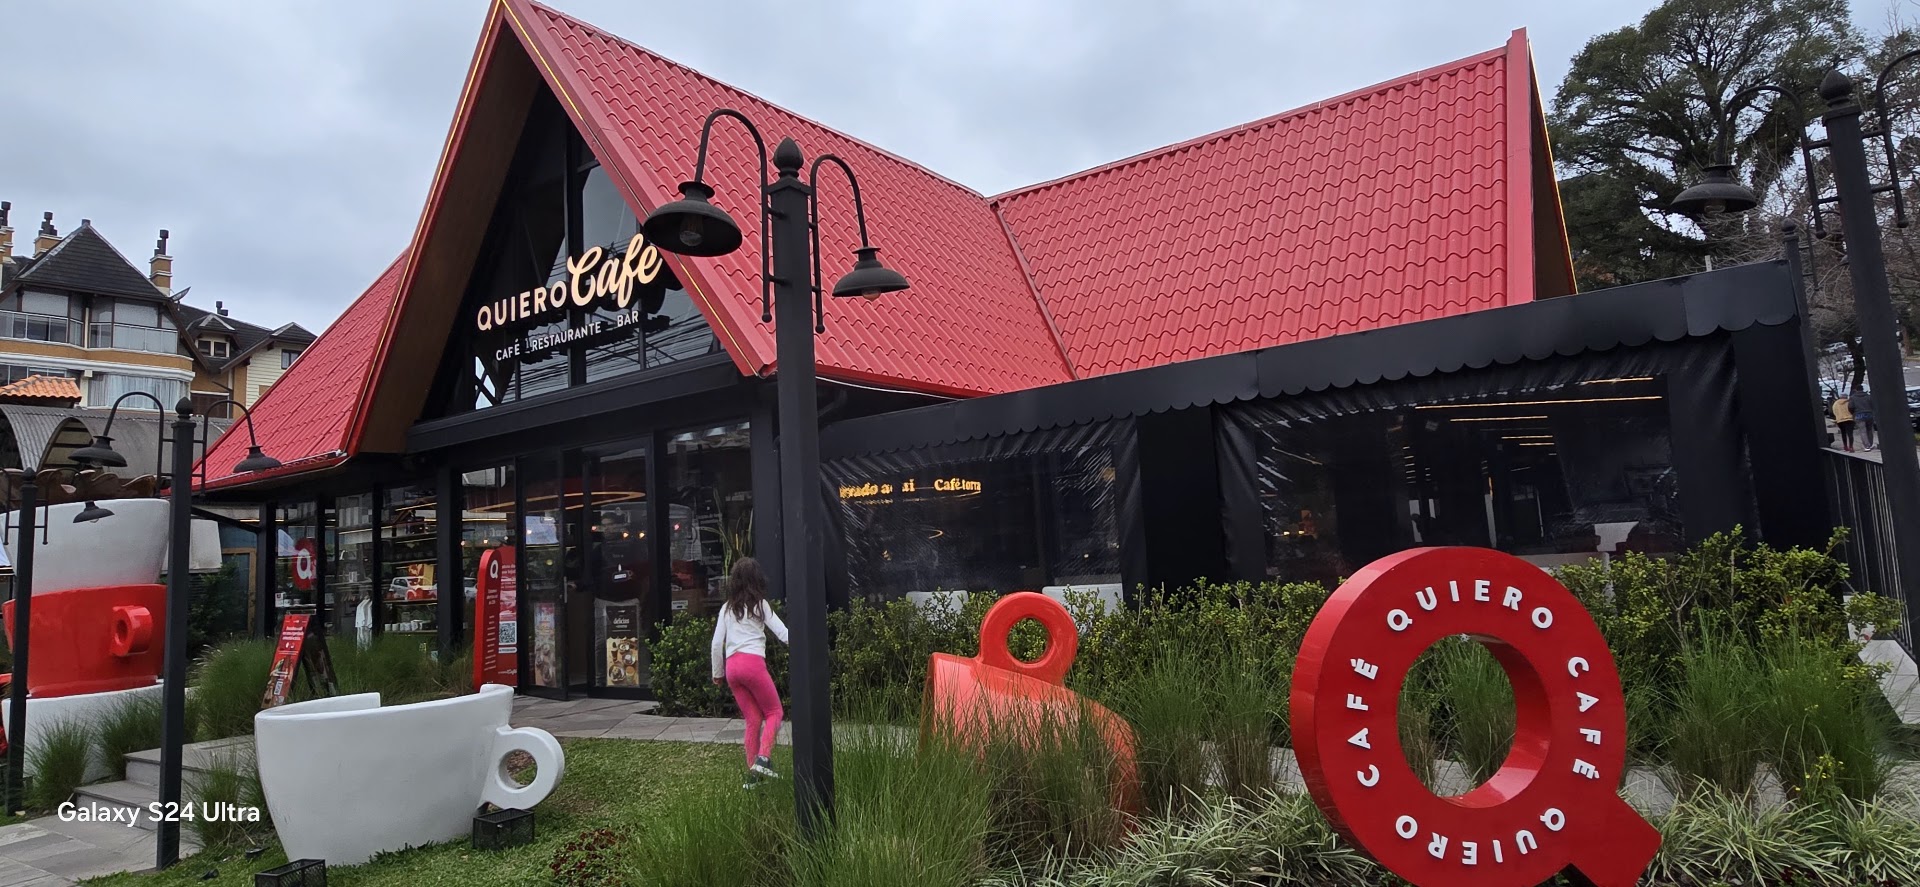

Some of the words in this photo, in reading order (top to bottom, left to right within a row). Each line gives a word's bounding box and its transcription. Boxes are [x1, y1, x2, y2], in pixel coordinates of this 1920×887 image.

[477, 280, 567, 331] QUIERO
[495, 338, 520, 361] CAFÉ
[532, 321, 601, 351] RESTAURANTE
[617, 310, 639, 328] BAR
[490, 559, 499, 579] Q
[1386, 579, 1553, 631] QUIERO
[1346, 657, 1380, 788] CAFÉ
[1567, 656, 1602, 780] CAFÉ
[1395, 807, 1566, 865] QUIERO
